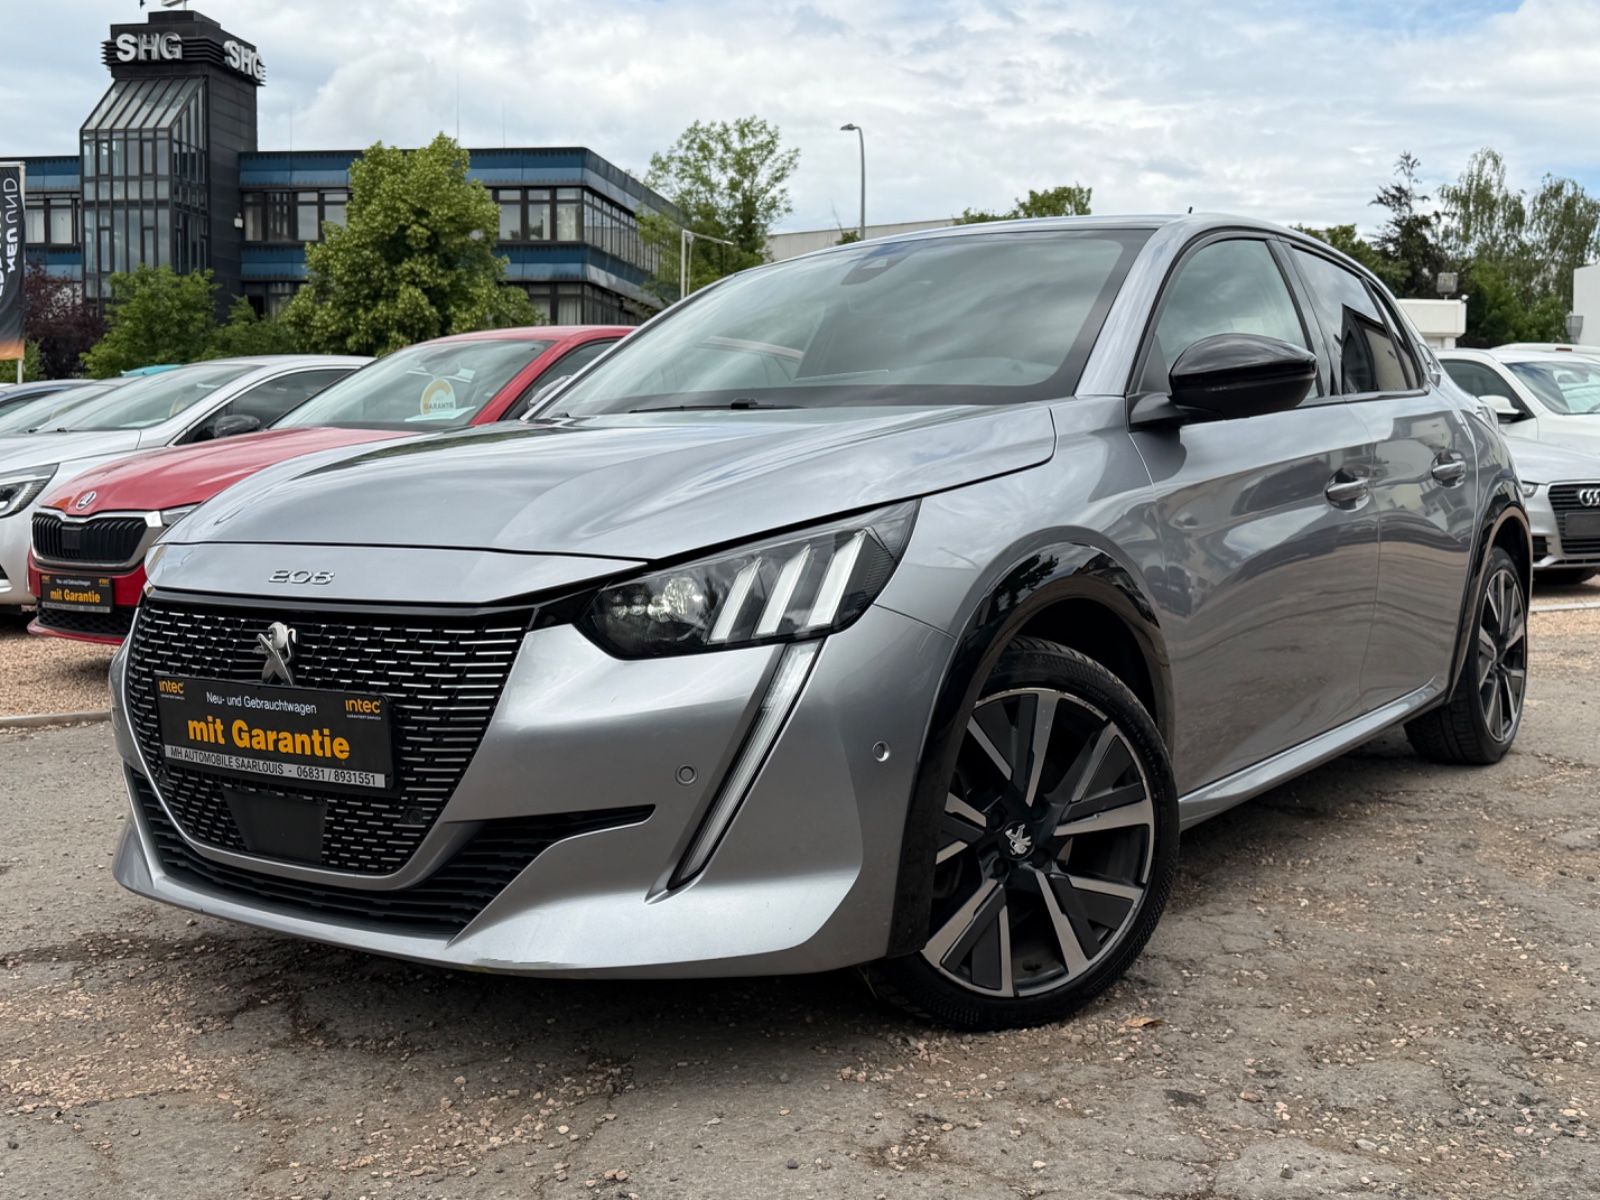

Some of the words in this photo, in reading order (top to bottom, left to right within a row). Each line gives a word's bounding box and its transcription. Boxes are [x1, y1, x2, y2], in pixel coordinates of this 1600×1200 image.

[116, 32, 182, 62] SHG
[224, 40, 264, 80] SHG
[268, 569, 335, 585] 208
[50, 588, 62, 600] mit
[64, 588, 100, 603] Garantie
[159, 680, 184, 694] intec
[206, 691, 225, 704] Neu-
[227, 694, 242, 707] und
[243, 695, 317, 716] Gebrauchtwagen
[345, 698, 381, 714] intec
[187, 715, 225, 745] mit
[231, 719, 350, 760] Garantie
[170, 747, 183, 758] MH
[184, 749, 233, 768] AUTOMOBILE
[234, 755, 284, 775] SAARLOUIS
[296, 767, 325, 781] 06831
[334, 771, 376, 785] 8931551
